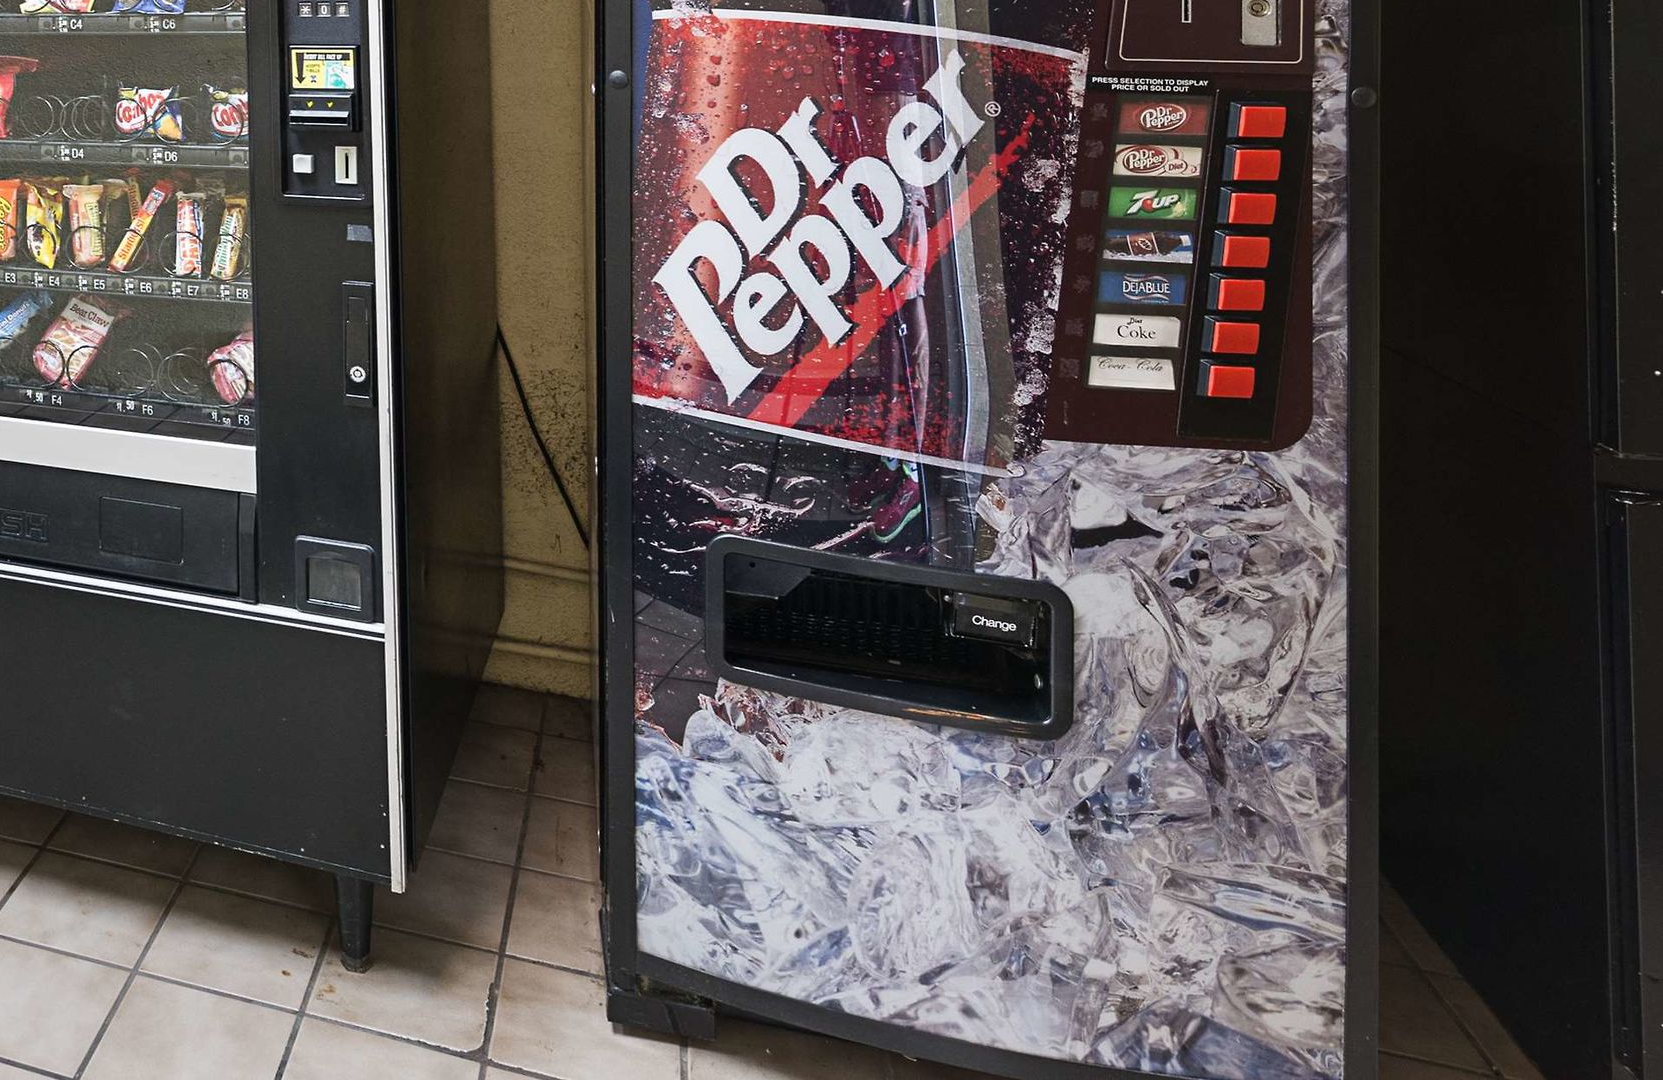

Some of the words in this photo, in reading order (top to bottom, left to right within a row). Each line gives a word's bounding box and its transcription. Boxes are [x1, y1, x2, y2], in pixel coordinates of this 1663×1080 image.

[321, 6, 327, 14] 0
[71, 19, 83, 30] C4
[162, 19, 176, 30] C6
[1158, 106, 1173, 117] Dr
[1145, 109, 1183, 128] Pepper
[165, 151, 178, 162] D6
[1140, 148, 1155, 159] Dr
[1128, 152, 1165, 169] Pepper
[1168, 161, 1184, 171] Diet
[696, 97, 841, 256] Dr
[652, 49, 985, 406] Pepper
[4, 273, 16, 283] E3
[48, 276, 60, 286] E4
[93, 280, 105, 290] E5
[140, 283, 152, 293] E6
[187, 286, 200, 296] E7
[1117, 325, 1156, 339] Coke
[51, 396, 62, 406] F4
[142, 404, 153, 416] F6
[238, 414, 250, 425] F8
[972, 615, 1017, 632] Change
